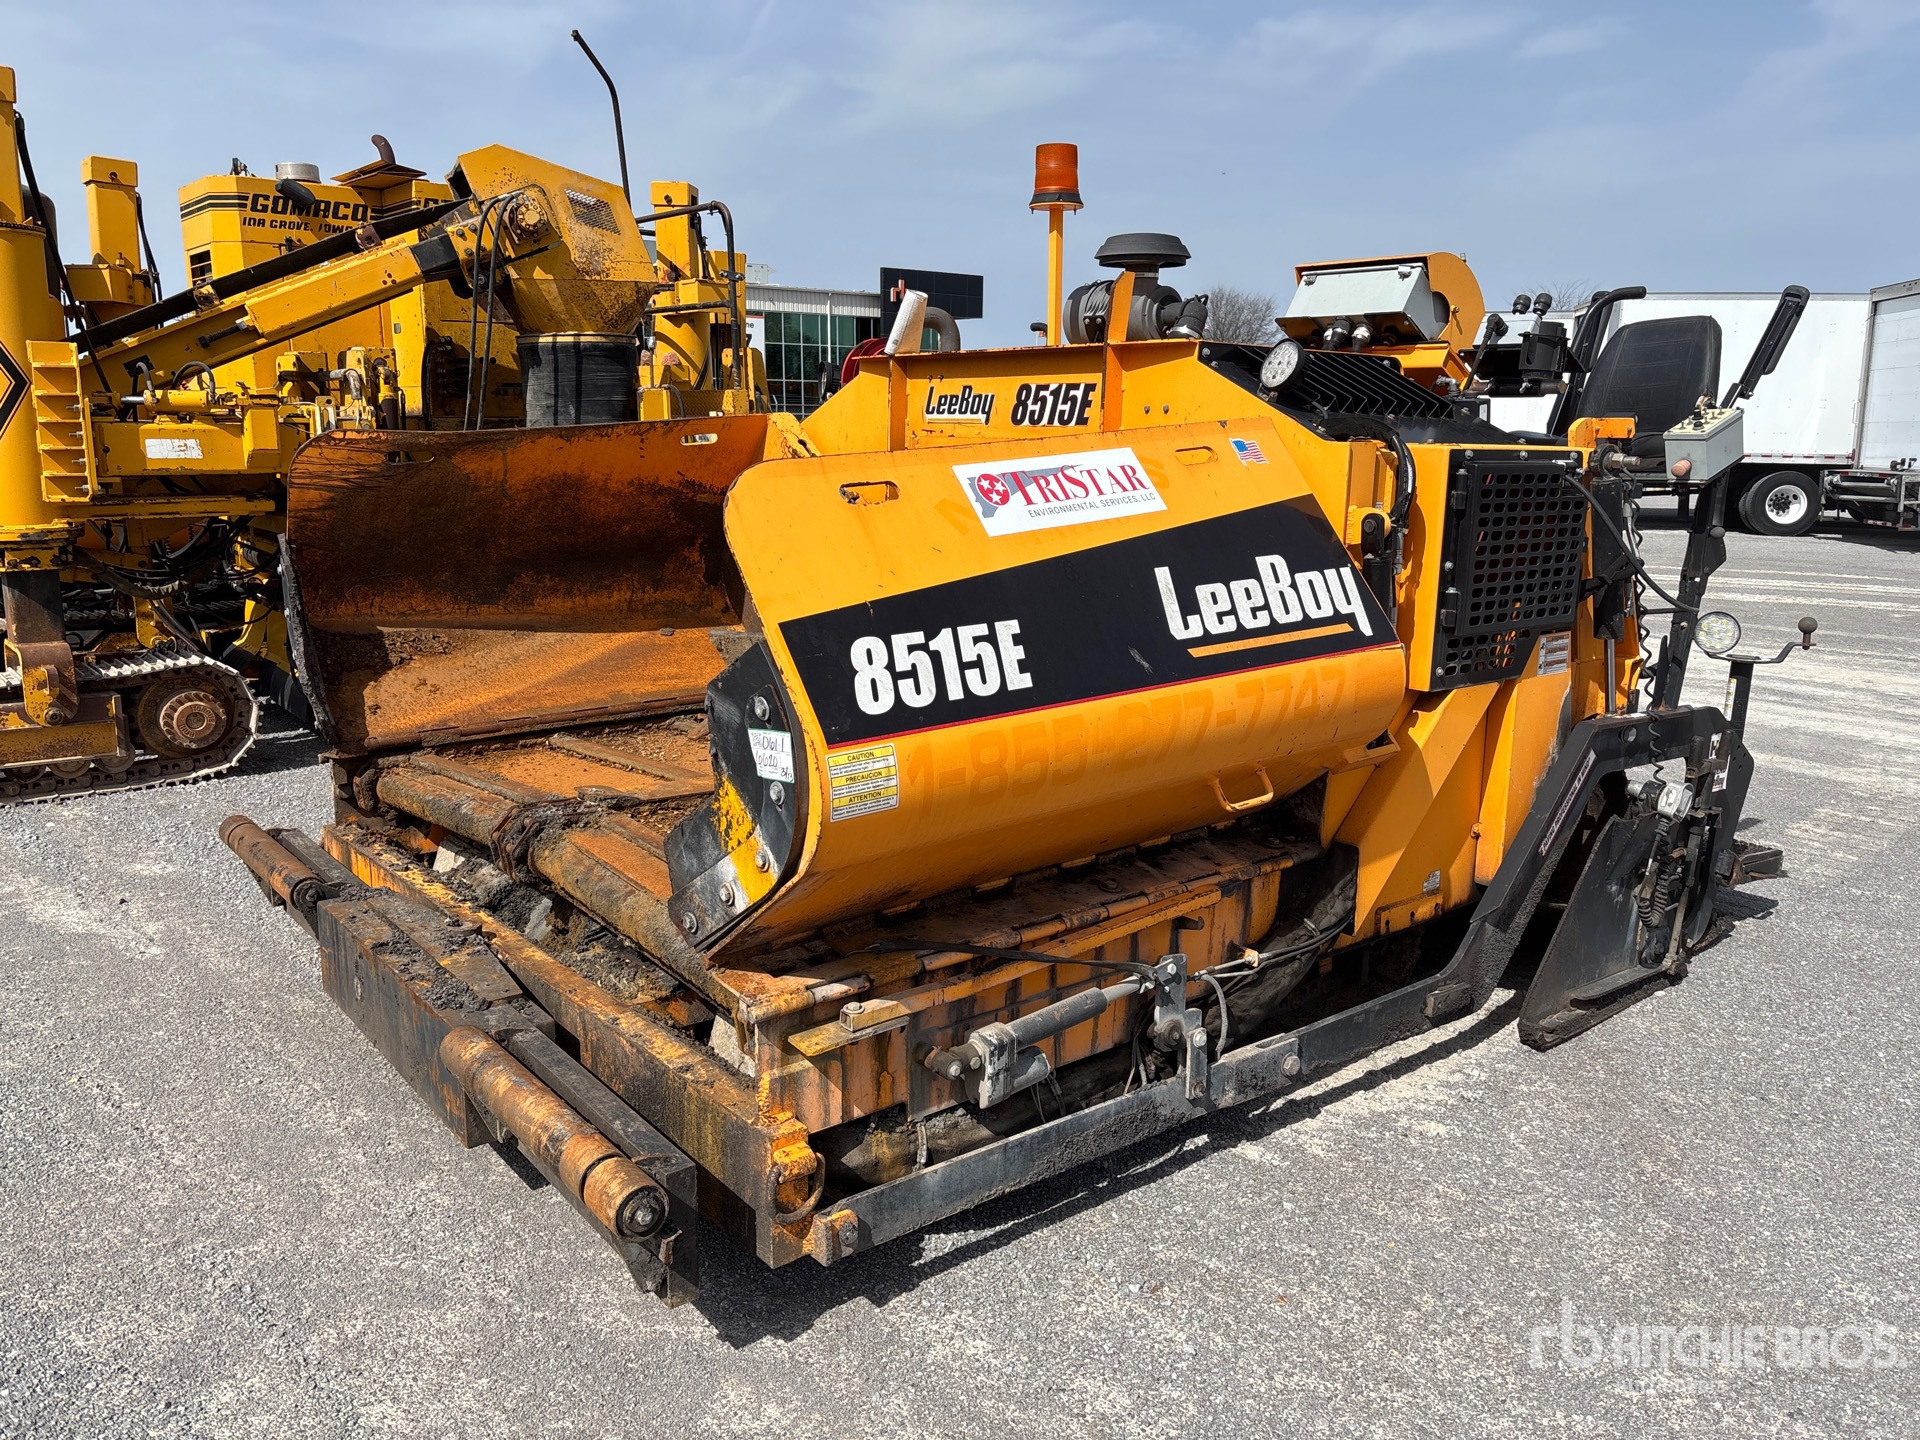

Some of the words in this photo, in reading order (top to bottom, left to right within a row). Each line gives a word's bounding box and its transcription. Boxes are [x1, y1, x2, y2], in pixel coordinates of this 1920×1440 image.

[242, 216, 266, 228] IDA
[925, 385, 995, 425] LeeBoy
[1011, 383, 1097, 426] 8515E
[1028, 501, 1100, 518] ENVIRONMENTAL
[1099, 495, 1140, 508] SERVICES,
[1139, 492, 1157, 502] LLC
[1153, 553, 1374, 639] LeeBoy
[850, 618, 1034, 716] 8515E
[847, 751, 875, 761] CAUTION
[848, 791, 882, 803] ATTENTION
